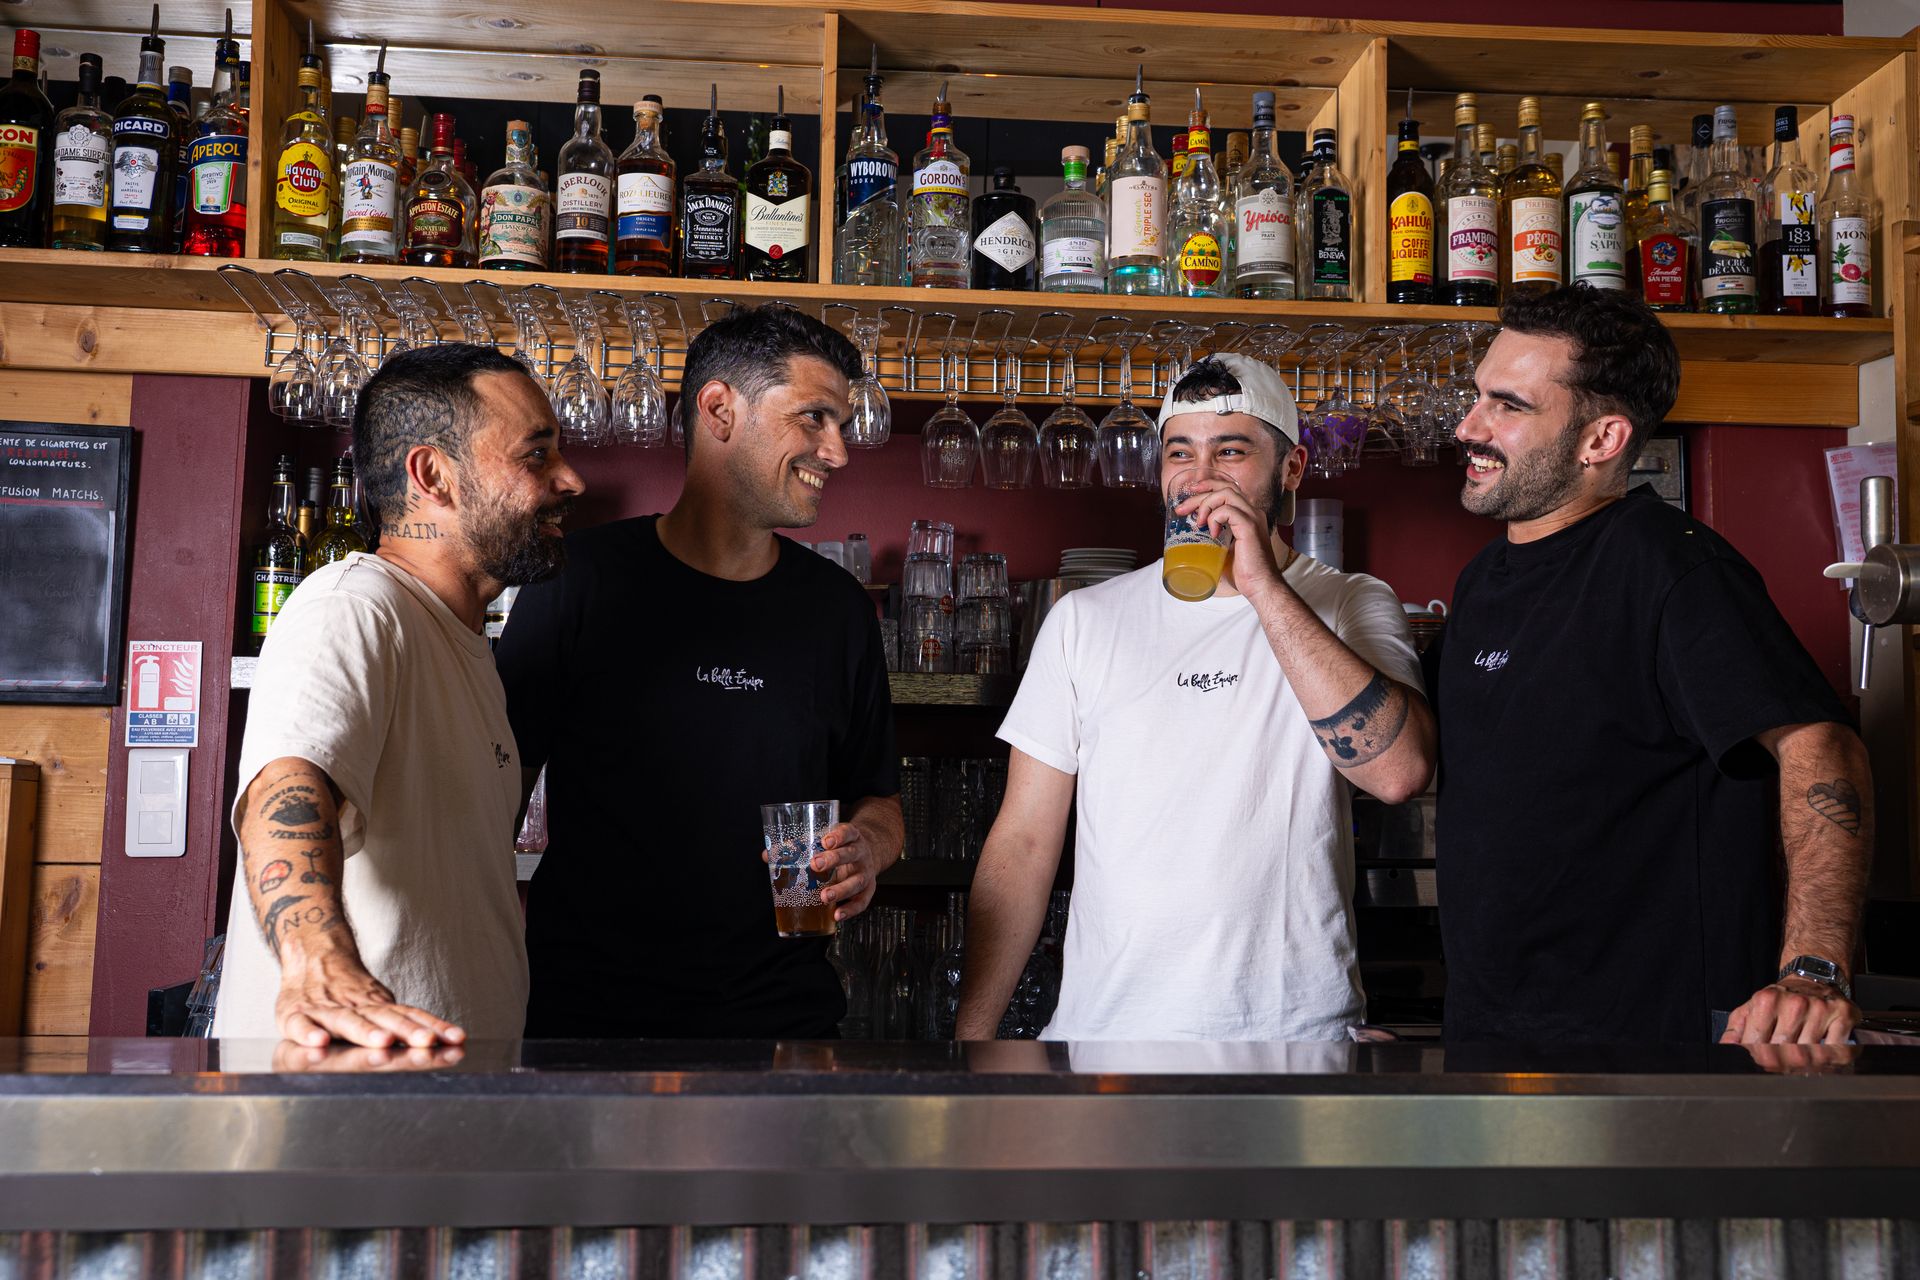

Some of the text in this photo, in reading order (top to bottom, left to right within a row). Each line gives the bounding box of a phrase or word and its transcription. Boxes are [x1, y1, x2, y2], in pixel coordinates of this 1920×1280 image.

[114, 120, 164, 133] RICARD
[191, 143, 240, 164] APEROL
[285, 164, 325, 179] Havana
[368, 164, 394, 183] Morgan
[292, 175, 317, 188] Club
[560, 176, 608, 196] ABERLOUR
[920, 173, 966, 187] GORDON'S
[288, 197, 319, 207] ORIGINAL
[563, 200, 603, 208] DISTILLERY
[687, 199, 705, 213] JACK
[705, 197, 732, 215] DANIEL'S
[409, 203, 459, 219] APPLETON ESTATE
[750, 205, 804, 222] Ballantine's
[1144, 192, 1152, 236] TRIPLE SEC
[515, 215, 535, 225] PAPA
[576, 216, 589, 228] 10
[693, 224, 724, 232] Tennessee
[1526, 231, 1559, 247] PÊCHE
[1391, 249, 1429, 260] LIQUEUR
[25, 439, 36, 447] DE
[40, 438, 90, 449] CIGARETTES
[93, 442, 108, 450] EST
[1475, 650, 1486, 667] La
[696, 666, 764, 691] La Belle Équipe
[1177, 673, 1189, 687] La
[1191, 674, 1211, 689] Belle
